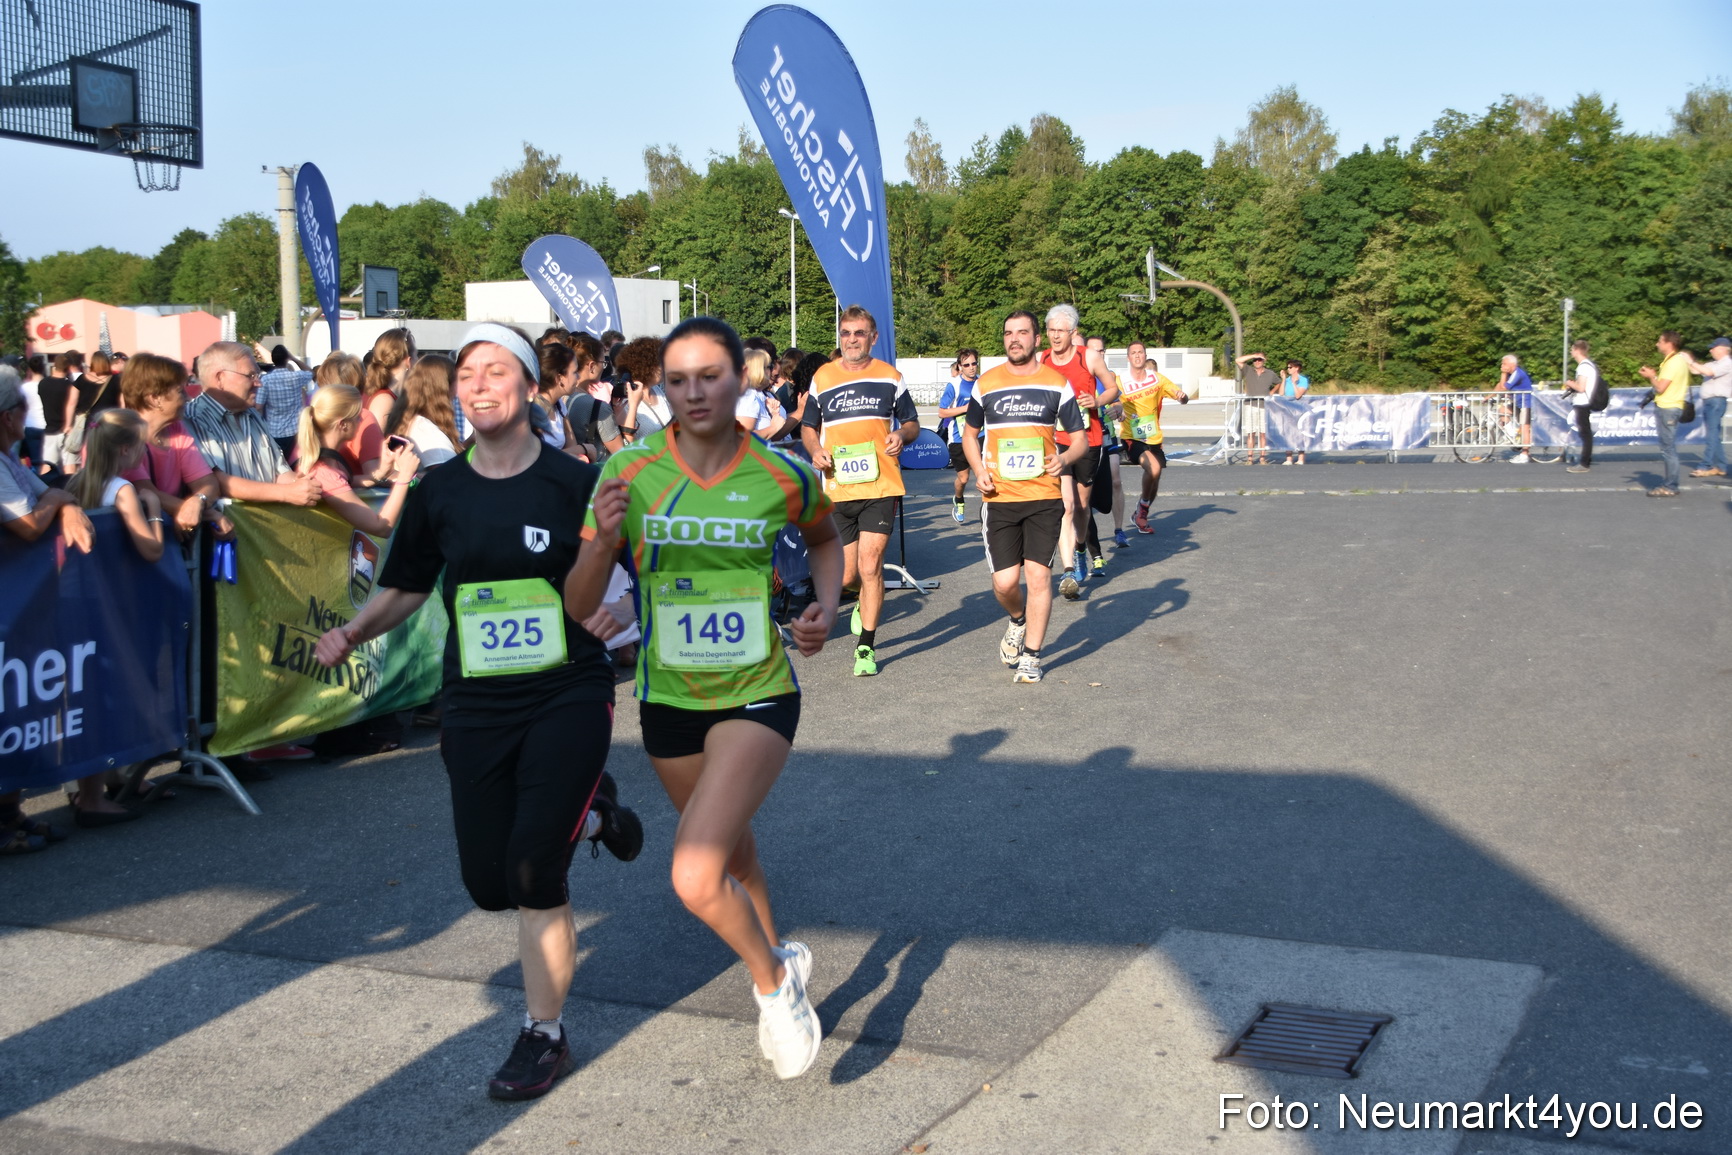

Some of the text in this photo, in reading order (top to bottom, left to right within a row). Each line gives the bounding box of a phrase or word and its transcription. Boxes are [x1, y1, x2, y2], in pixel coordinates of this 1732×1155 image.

[835, 394, 881, 409] Fischer
[1003, 402, 1045, 412] Fischer
[840, 405, 879, 413] AUTOMOBILE
[1588, 411, 1657, 429] Fische
[1136, 424, 1153, 435] 876
[1593, 429, 1658, 438] AUTOMOBIL
[841, 459, 869, 474] 406
[1006, 455, 1036, 468] 472
[643, 514, 768, 548] BOCK
[480, 617, 544, 650] 325
[677, 611, 745, 644] 149
[484, 652, 545, 662] Annemarie Altmann
[705, 650, 746, 659] Degenhardt
[0, 707, 84, 754] OBILE
